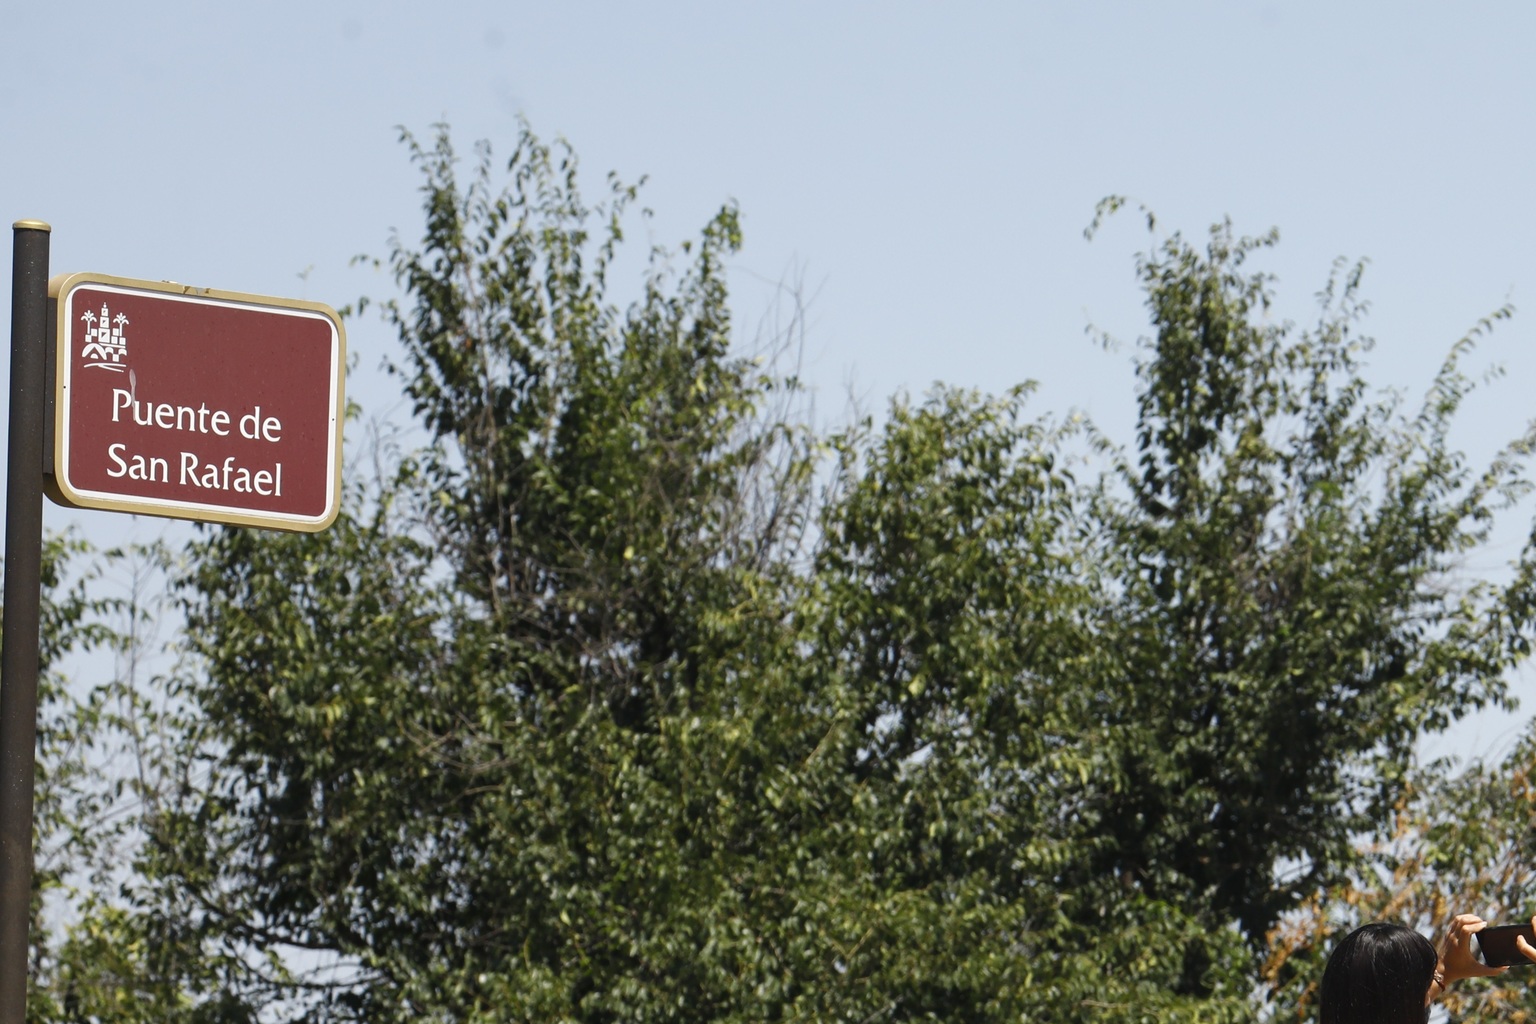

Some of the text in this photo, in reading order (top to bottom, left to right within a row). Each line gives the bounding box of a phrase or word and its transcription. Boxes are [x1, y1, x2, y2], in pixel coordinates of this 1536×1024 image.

[112, 388, 282, 443] Puente de
[106, 443, 282, 497] San Rafael
